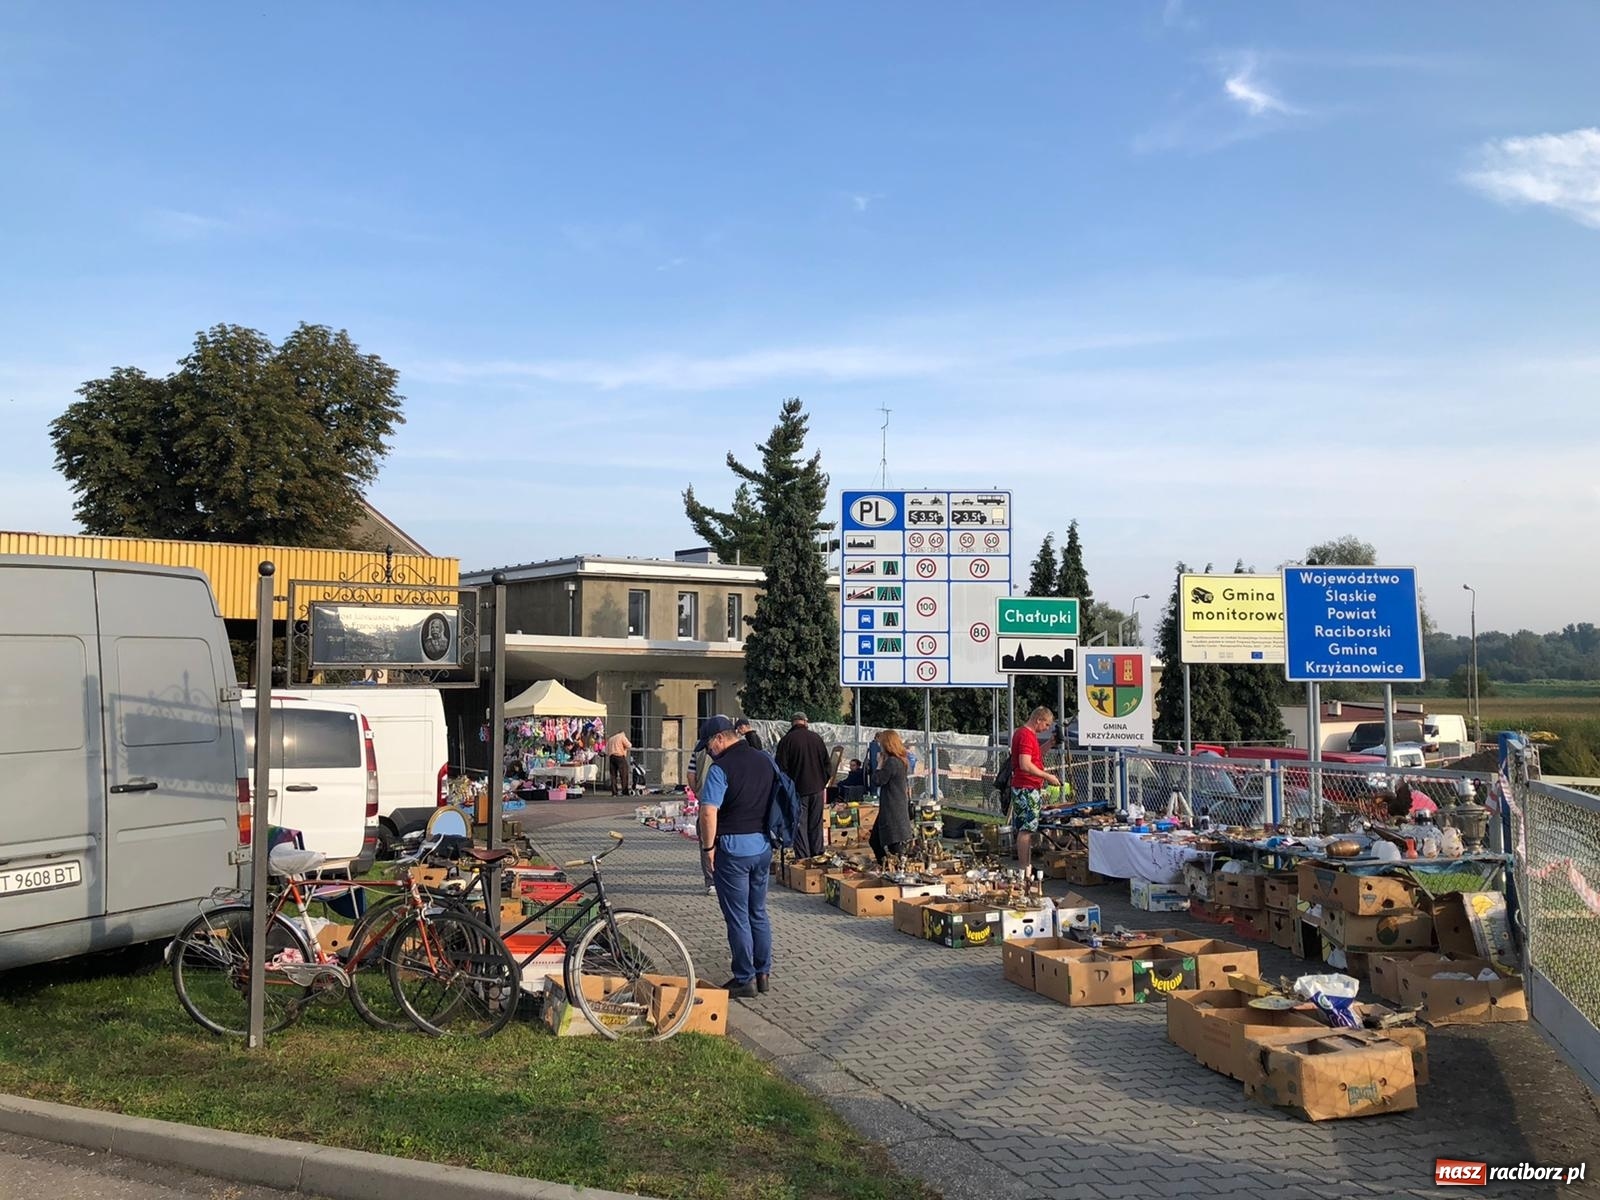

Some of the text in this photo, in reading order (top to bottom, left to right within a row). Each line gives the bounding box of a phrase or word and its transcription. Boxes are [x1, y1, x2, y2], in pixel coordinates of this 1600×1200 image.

[859, 501, 886, 521] PL
[911, 536, 922, 544] 50
[931, 536, 941, 544] 60
[962, 536, 973, 544] 50
[986, 536, 997, 544] 60
[920, 563, 933, 573] 90
[974, 563, 986, 573] 70
[1299, 572, 1400, 587] Województwo
[1222, 588, 1275, 601] Gmina
[1325, 586, 1377, 604] Śląskie
[920, 603, 934, 611] 100
[1004, 610, 1071, 627] Chałupki
[1327, 607, 1377, 619] Powiat
[973, 628, 987, 638] 80
[1315, 625, 1391, 637] Raciborski
[920, 641, 934, 650] 10
[1328, 643, 1378, 655] Gmina
[920, 667, 934, 675] 10
[1305, 661, 1404, 676] Krzyżanowice
[1086, 731, 1144, 740] KRZYŻANOWICE
[15, 870, 51, 889] 9608
[54, 866, 75, 883] BT
[1148, 969, 1183, 991] yellow
